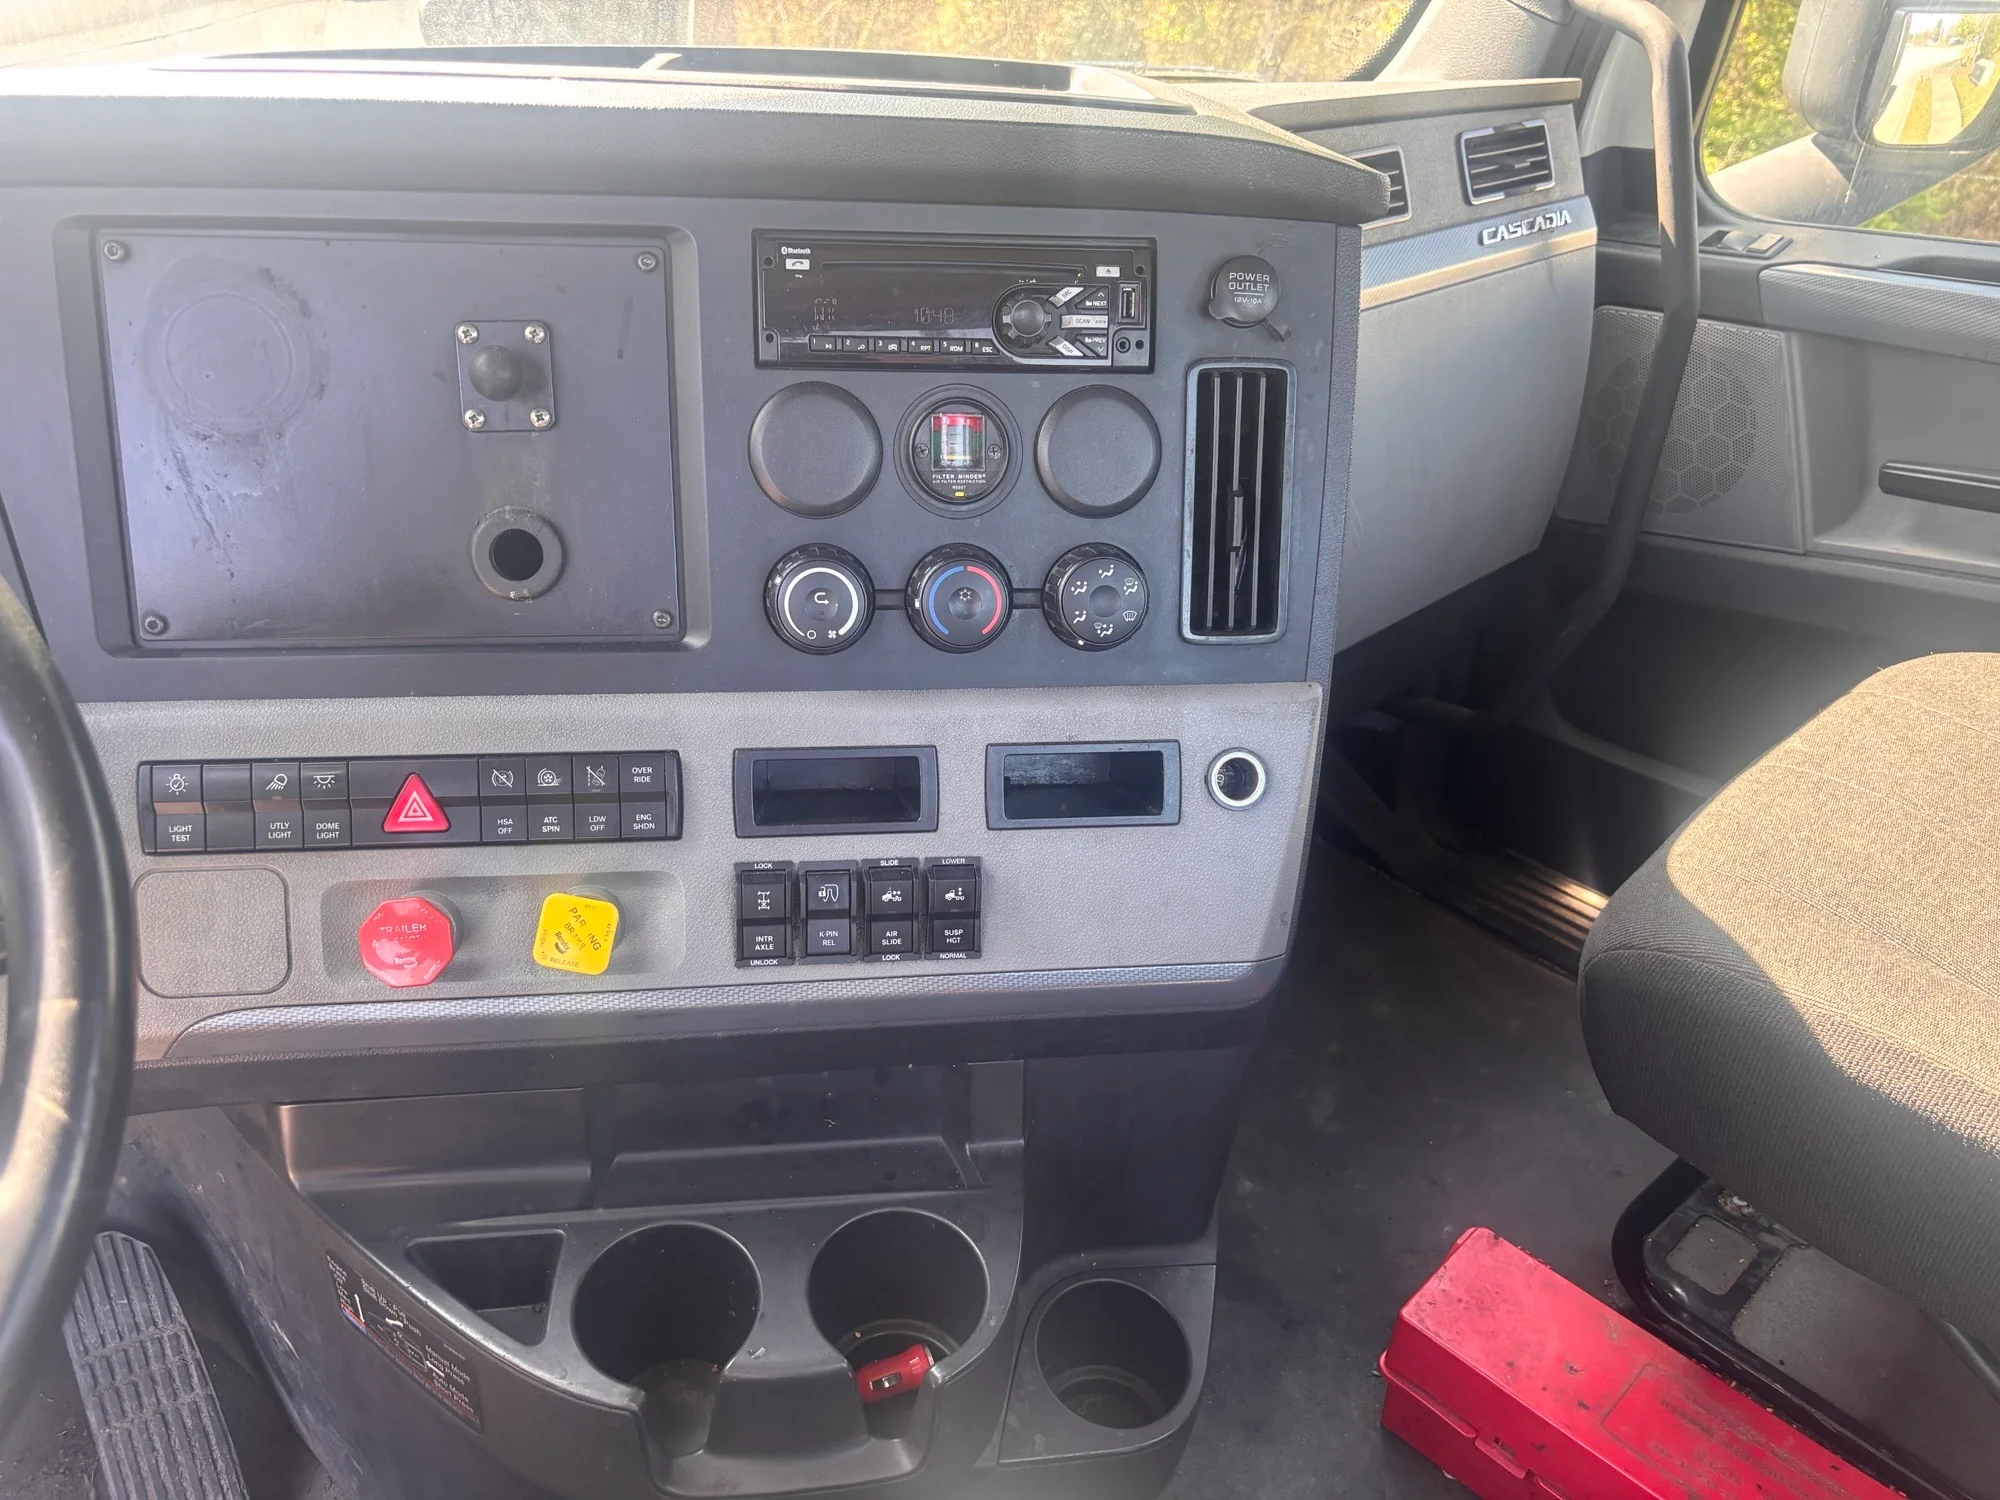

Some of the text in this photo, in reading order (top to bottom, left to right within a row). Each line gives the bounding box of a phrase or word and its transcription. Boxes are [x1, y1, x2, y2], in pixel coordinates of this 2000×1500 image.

[1482, 209, 1572, 245] CASCADIA
[788, 247, 811, 255] Bluetooth
[1229, 272, 1270, 282] POWER
[1228, 281, 1269, 292] OUTLET
[632, 766, 653, 775] OVER
[634, 775, 652, 783] RIDE
[543, 816, 558, 824] ATC
[589, 815, 606, 823] LDW
[636, 813, 652, 821] ENG
[270, 822, 290, 830] UTLY
[316, 822, 340, 830] DOME
[497, 818, 513, 826] HSA
[633, 821, 655, 830] SHDN
[168, 824, 193, 833] LIGHT
[497, 826, 513, 834] OFF
[542, 824, 560, 833] SPIN
[590, 823, 605, 832] OFF
[171, 833, 191, 842] TEST
[268, 830, 292, 839] LIGHT
[316, 830, 340, 839] LIGHT
[819, 930, 838, 938] K-PIN
[755, 935, 773, 943] INTR
[881, 938, 902, 946] SLIDE
[755, 943, 774, 951] AXLE
[940, 952, 967, 960] NORMAL
[750, 958, 778, 966] UNLOCK
[425, 1344, 450, 1367] Manual
[451, 1364, 471, 1381] Mode
[428, 1353, 465, 1386] Long Press
[432, 1372, 469, 1403] Auto Mode
[434, 1379, 474, 1413] Short Press
